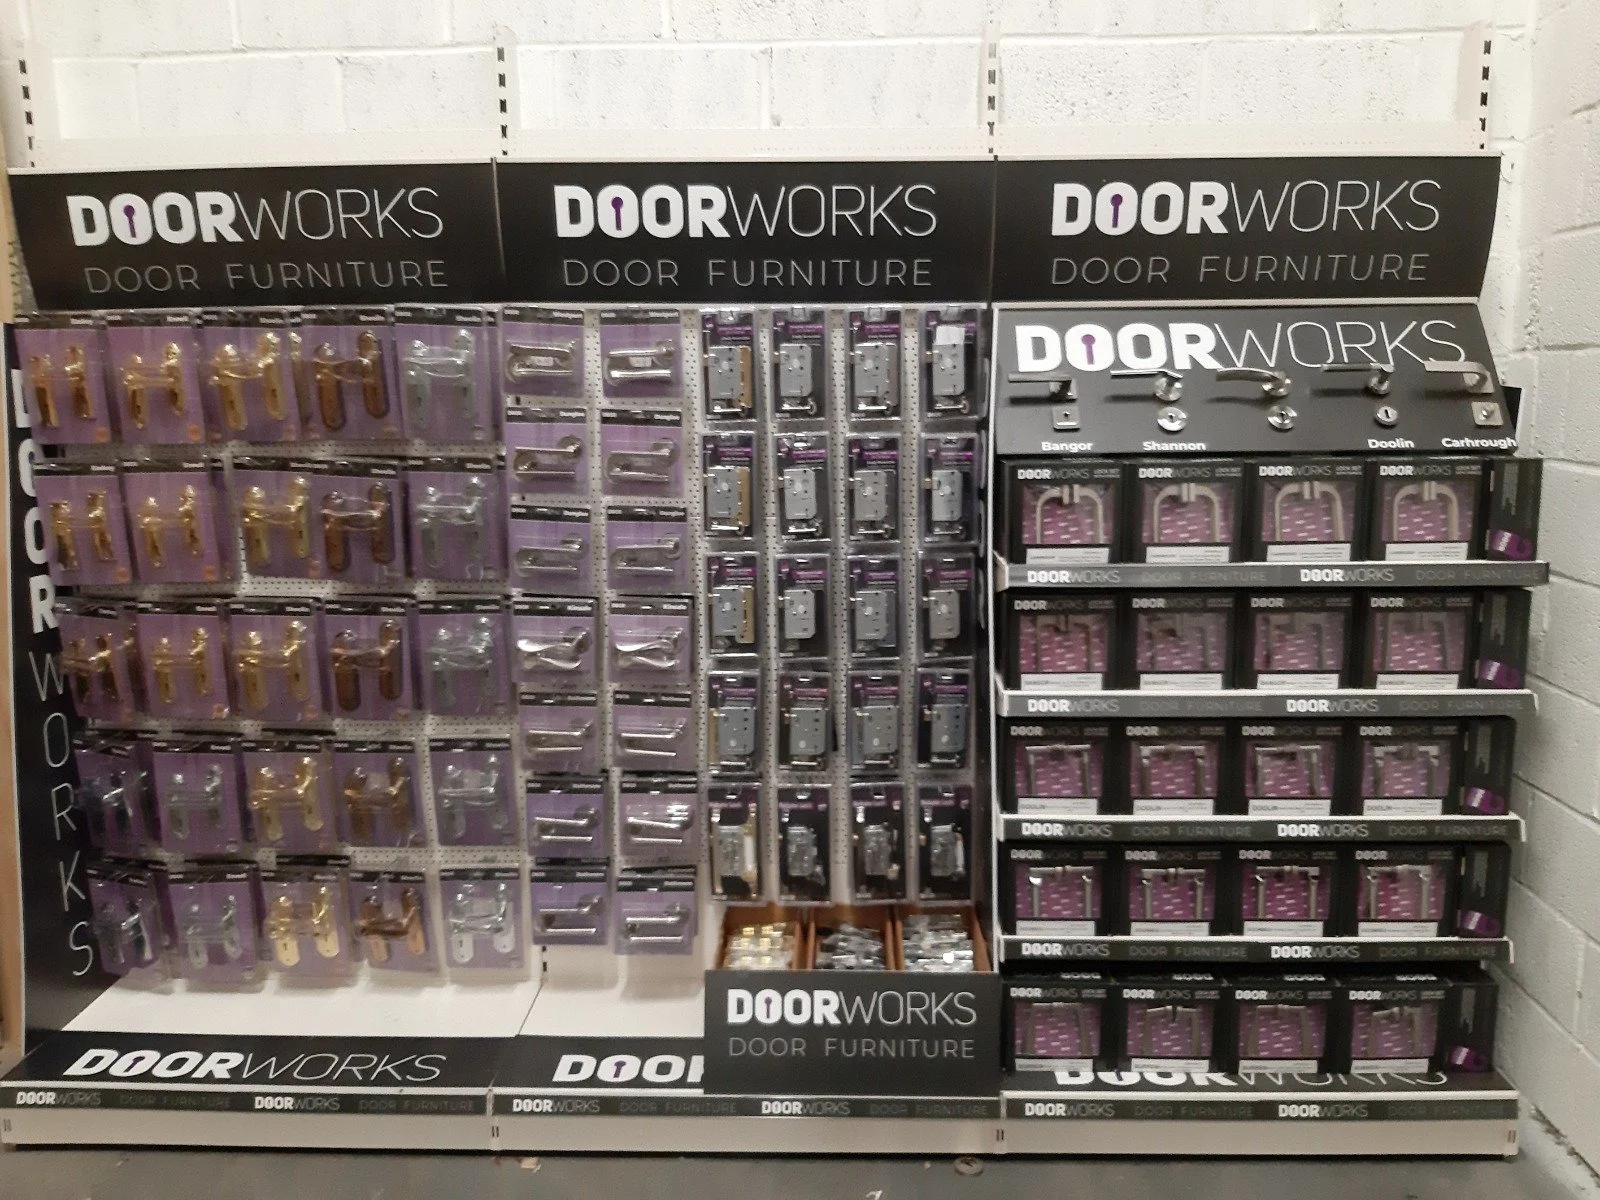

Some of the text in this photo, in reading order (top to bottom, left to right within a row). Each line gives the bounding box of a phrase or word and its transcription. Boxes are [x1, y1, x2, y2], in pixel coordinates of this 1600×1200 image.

[554, 184, 938, 240] DOORWORKS
[1051, 179, 1442, 236] DOORWORKS
[66, 187, 444, 247] DOORWORKS
[563, 259, 933, 287] DOOR FURNITURE
[1051, 254, 1430, 285] DOOR FURNITURE
[84, 259, 448, 294] DOOR FURNITURE
[1015, 320, 1466, 372] DOORWORKS
[1041, 441, 1093, 453] Bangor
[1143, 441, 1206, 451] Shannon
[1368, 438, 1415, 449] Doolin
[1441, 437, 1517, 450] Carhrough
[1017, 468, 1089, 480] DOORWORKS
[1139, 467, 1211, 479] DOORWORKS
[1259, 465, 1331, 477] DOORWORKS
[1379, 465, 1451, 476] DOORWORKS
[1027, 570, 1120, 583] DOORWORKS
[1300, 569, 1395, 582] DOORWORKS
[1028, 699, 1120, 712] DOORWORKS
[1286, 699, 1379, 712] DOORWORKS
[1022, 823, 1112, 837] DOORWORKS
[1277, 824, 1369, 837] DOORWORKS
[1022, 943, 1110, 956] DOORWORKS
[1271, 946, 1360, 959] DOORWORKS
[726, 988, 977, 1026] DOORWORKS
[728, 1037, 975, 1058] DOOR FURNITURE
[63, 1048, 447, 1082] DOORWORKS
[16, 1091, 101, 1106] DOORWORKS
[254, 1095, 340, 1111] DOORWORKS
[512, 1099, 600, 1113] DOORWORKS
[761, 1101, 851, 1115] DOORWORKS
[1025, 1103, 1115, 1116] DOORWORKS
[1278, 1104, 1368, 1117] DOORWORKS
